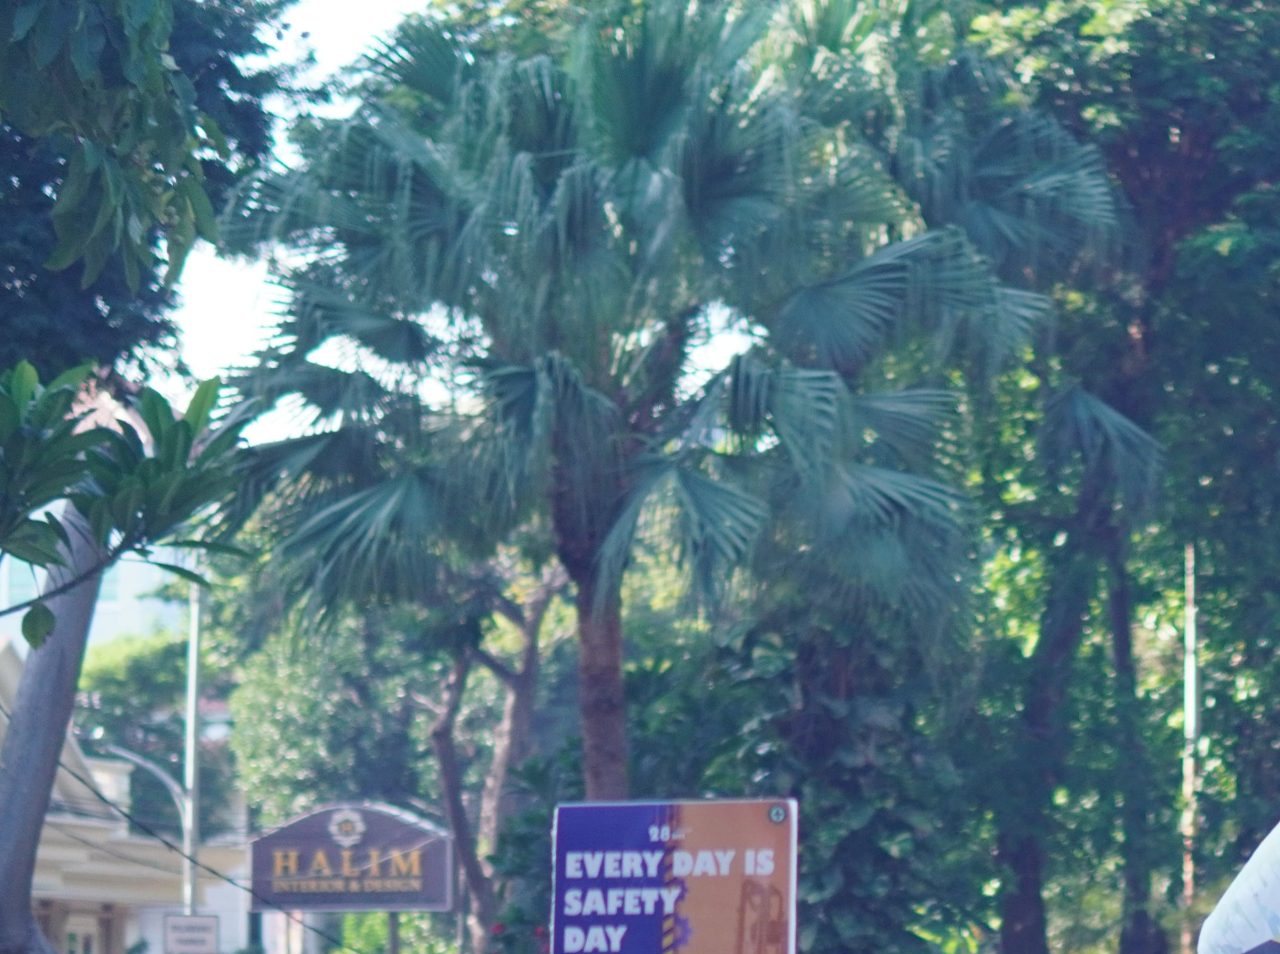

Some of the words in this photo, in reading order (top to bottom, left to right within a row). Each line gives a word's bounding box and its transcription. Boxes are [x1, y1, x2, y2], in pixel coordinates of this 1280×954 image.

[273, 848, 422, 878] HALIM
[565, 850, 664, 879] EVERY
[672, 849, 736, 877] DAY
[744, 849, 775, 876] IS
[564, 886, 681, 916] SAFETY
[563, 925, 627, 953] DAY
